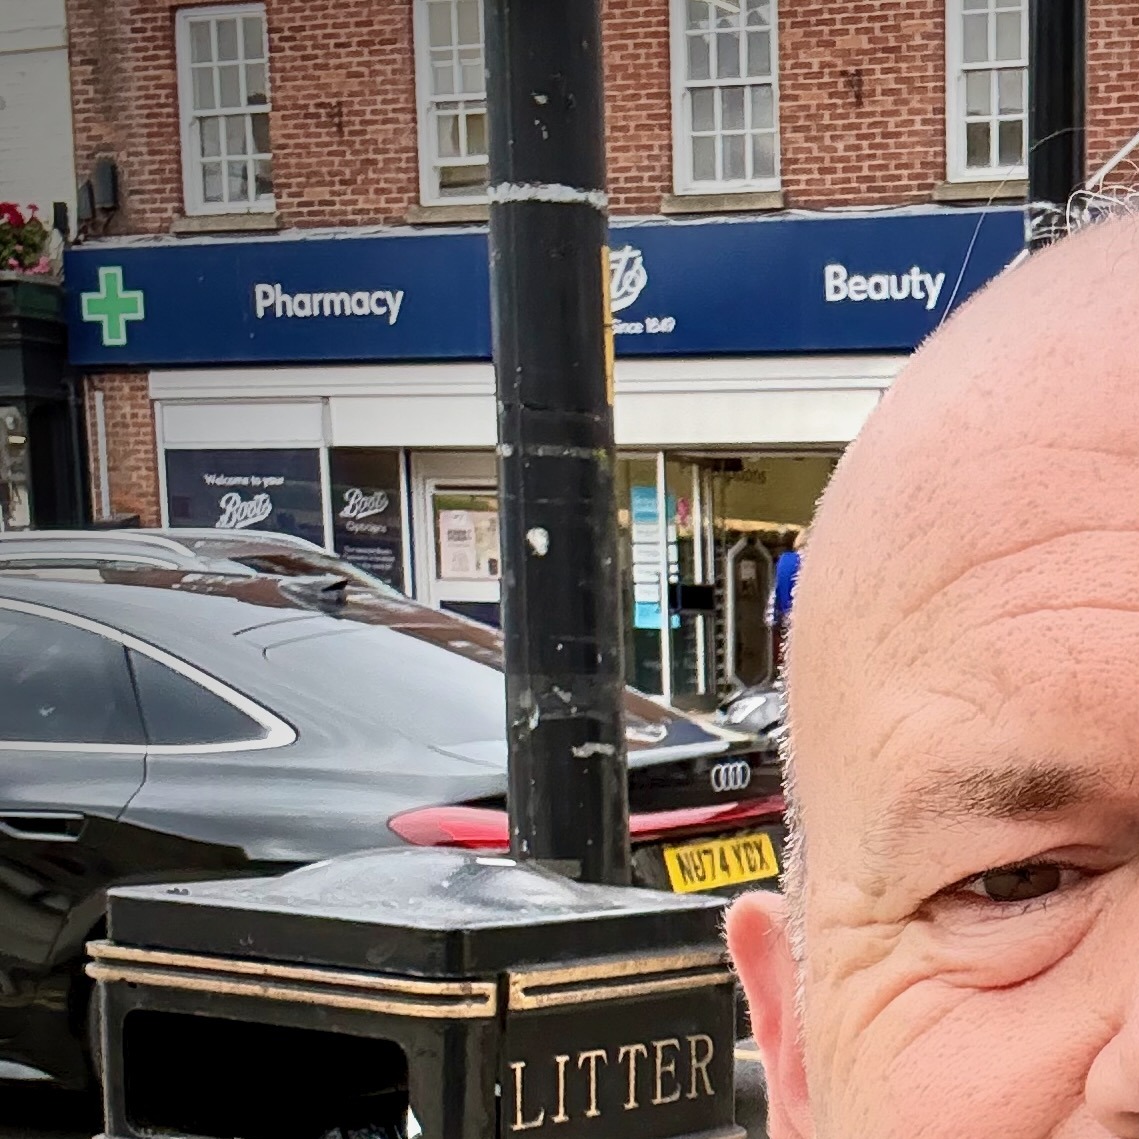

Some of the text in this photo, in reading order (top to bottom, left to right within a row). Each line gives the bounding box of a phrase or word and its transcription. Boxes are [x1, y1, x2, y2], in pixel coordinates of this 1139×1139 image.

[254, 282, 404, 326] Pharmacy
[824, 264, 946, 311] Beauty
[215, 492, 273, 529] Boots
[338, 487, 389, 520] Boots
[508, 1033, 716, 1132] LITTER
